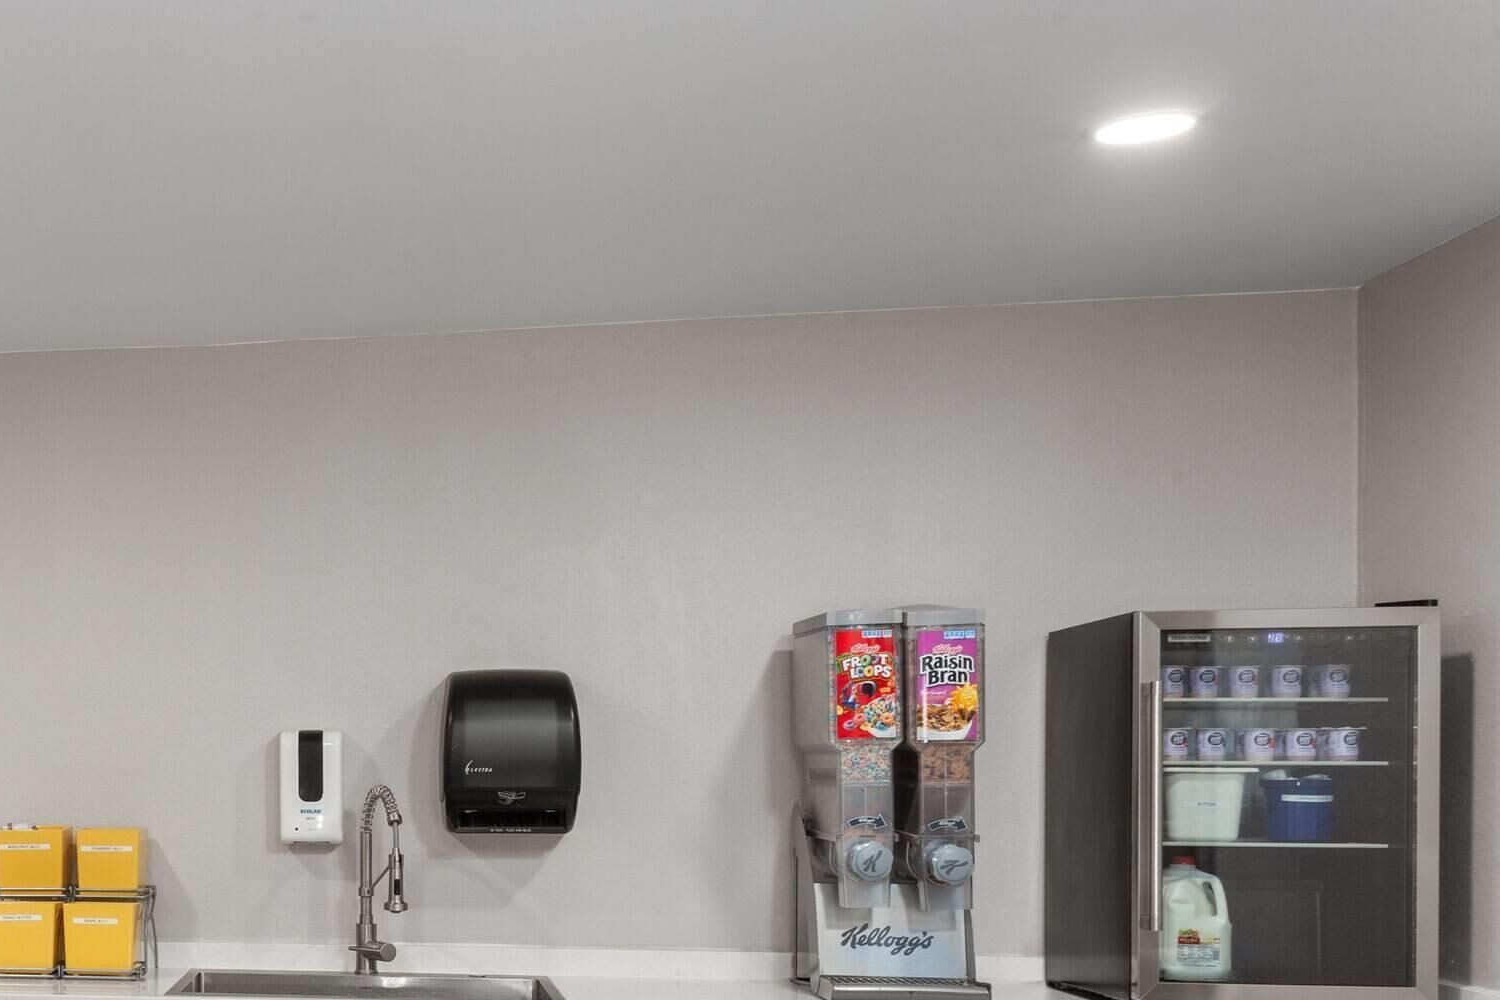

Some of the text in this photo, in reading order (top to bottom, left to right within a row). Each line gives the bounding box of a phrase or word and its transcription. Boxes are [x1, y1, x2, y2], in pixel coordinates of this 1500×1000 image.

[842, 653, 889, 672] FROOT
[921, 655, 973, 672] Raisin
[850, 664, 893, 679] LOOPS
[928, 670, 968, 685] Bran
[841, 923, 934, 956] Kellogg's
